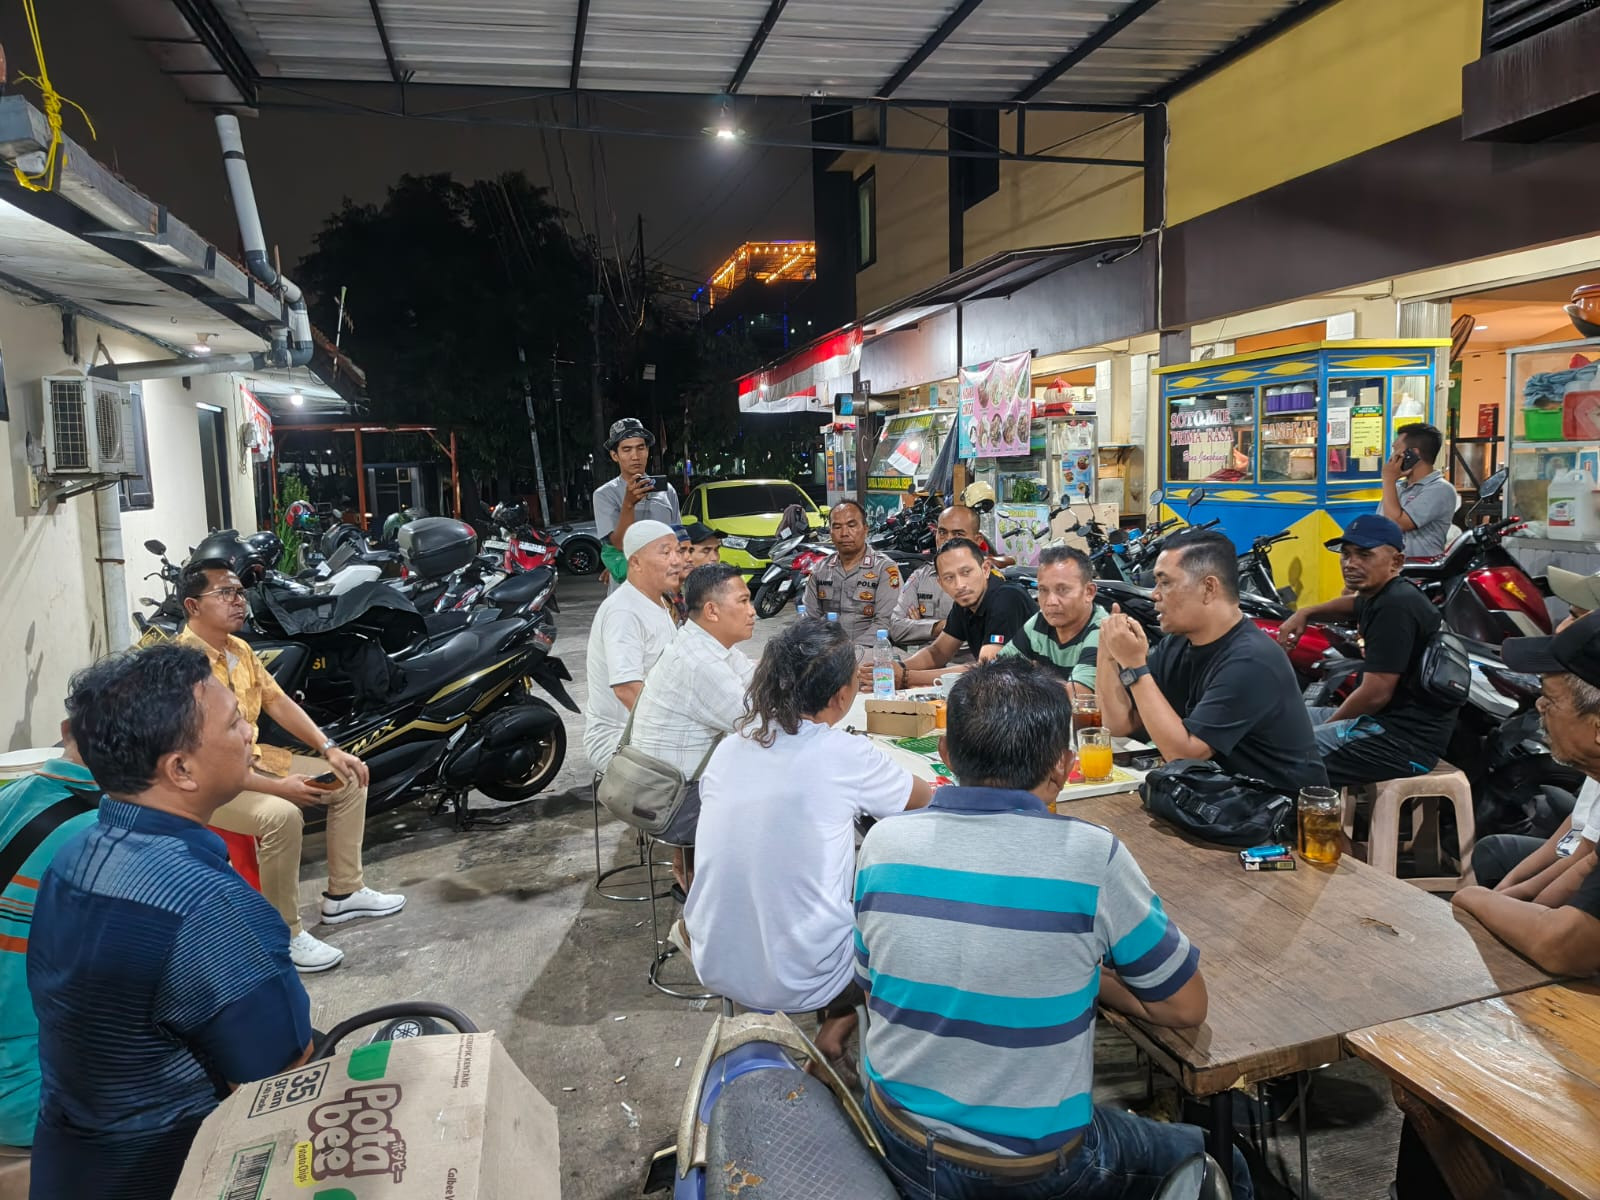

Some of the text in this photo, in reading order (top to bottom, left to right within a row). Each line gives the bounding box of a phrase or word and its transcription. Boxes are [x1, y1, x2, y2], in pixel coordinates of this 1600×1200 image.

[1170, 426, 1234, 446] PRIMA RASA
[286, 1070, 321, 1103] 35
[460, 1058, 472, 1088] KENTANG
[269, 1078, 289, 1109] gram
[311, 1101, 363, 1175] bee
[348, 1085, 400, 1175] Pota
[445, 1167, 458, 1197] Calbee
